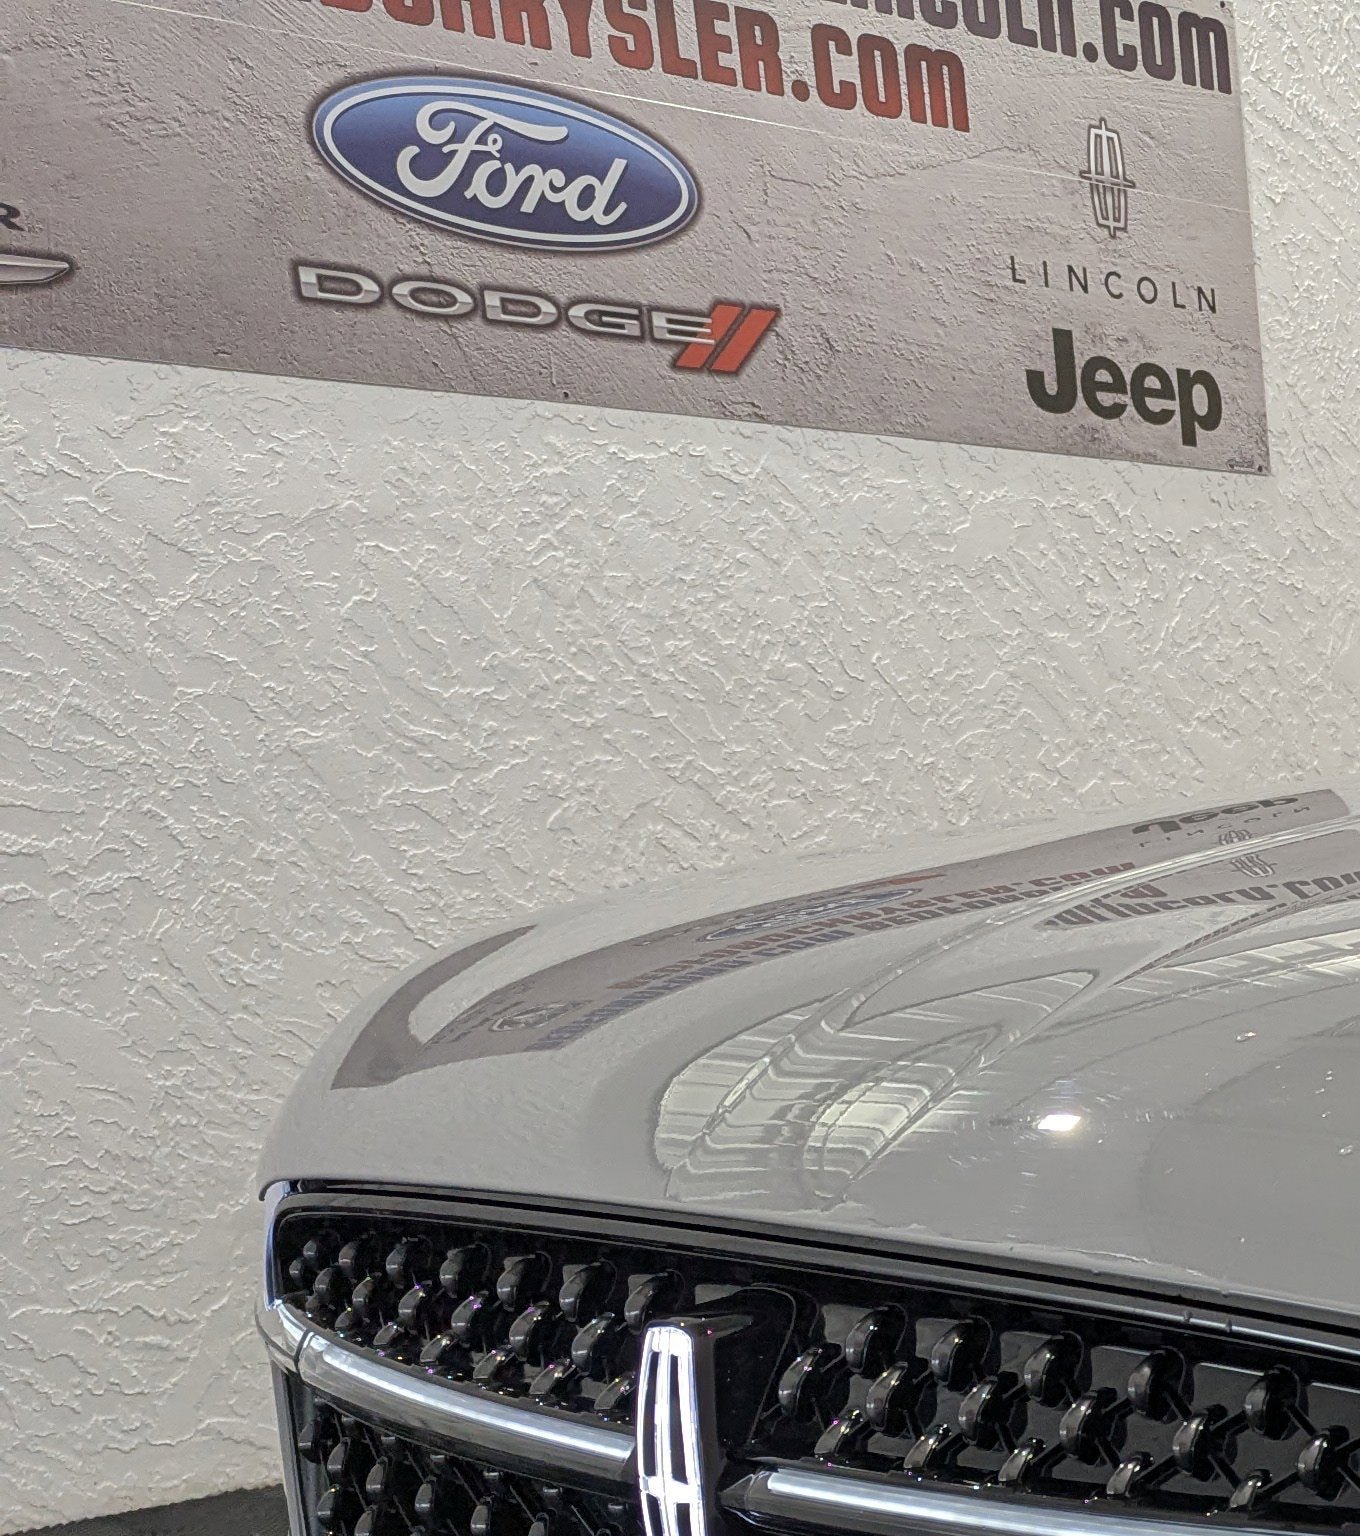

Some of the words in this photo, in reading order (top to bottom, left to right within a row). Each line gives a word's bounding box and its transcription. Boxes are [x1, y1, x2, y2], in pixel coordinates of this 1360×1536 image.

[396, 100, 628, 226] Ford
[297, 265, 716, 345] DODGE
[1010, 256, 1217, 314] LINCOLN
[1025, 328, 1223, 447] Jeep
